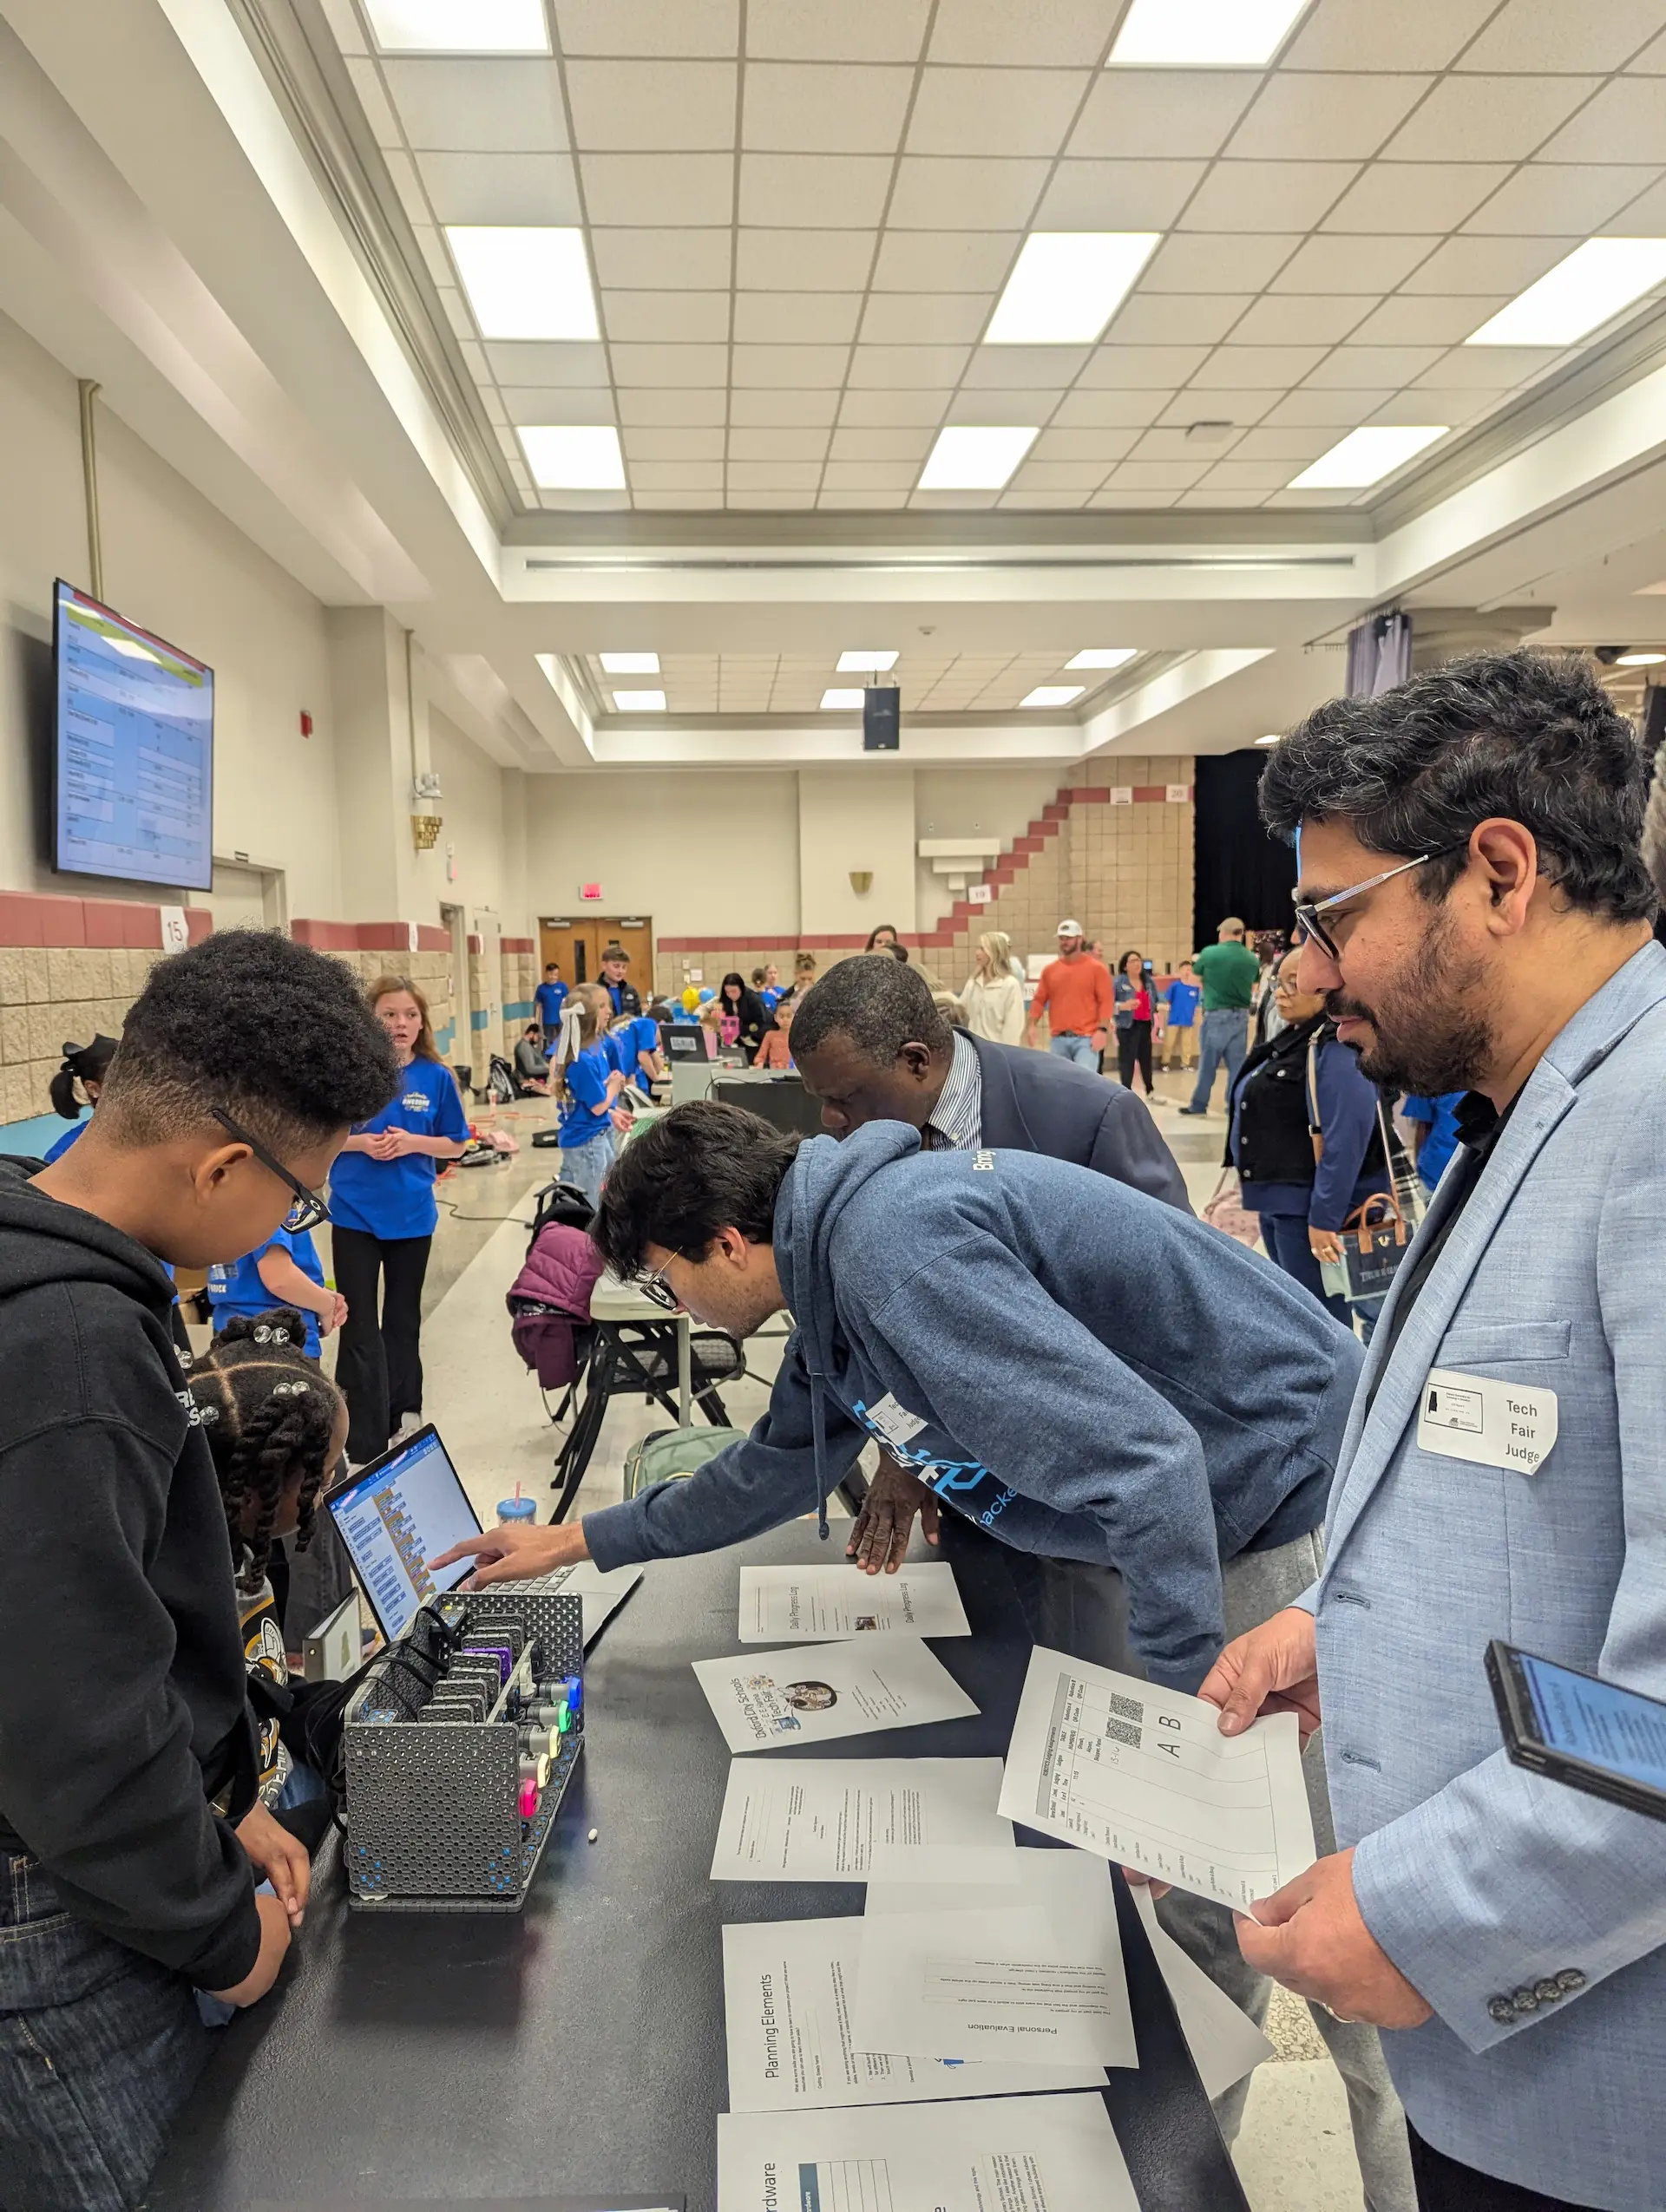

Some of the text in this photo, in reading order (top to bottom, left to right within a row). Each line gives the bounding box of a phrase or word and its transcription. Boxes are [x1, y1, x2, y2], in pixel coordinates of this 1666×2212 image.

[167, 921, 183, 942] 15
[1505, 1399, 1538, 1417] Tech
[1511, 1423, 1536, 1439] Fair
[1505, 1443, 1540, 1463] Judge
[789, 1587, 801, 1630] Daily Progress Log
[902, 1591, 912, 1612] Progress
[904, 1612, 915, 1623] Daily
[730, 1678, 766, 1738] Oxford City Schools
[760, 1691, 783, 1718] Tech Fair
[1158, 1716, 1181, 1731] B
[1157, 1744, 1181, 1758] A
[760, 1974, 779, 2078] Planning Elements
[967, 2024, 1057, 2035] Personal Evaluation
